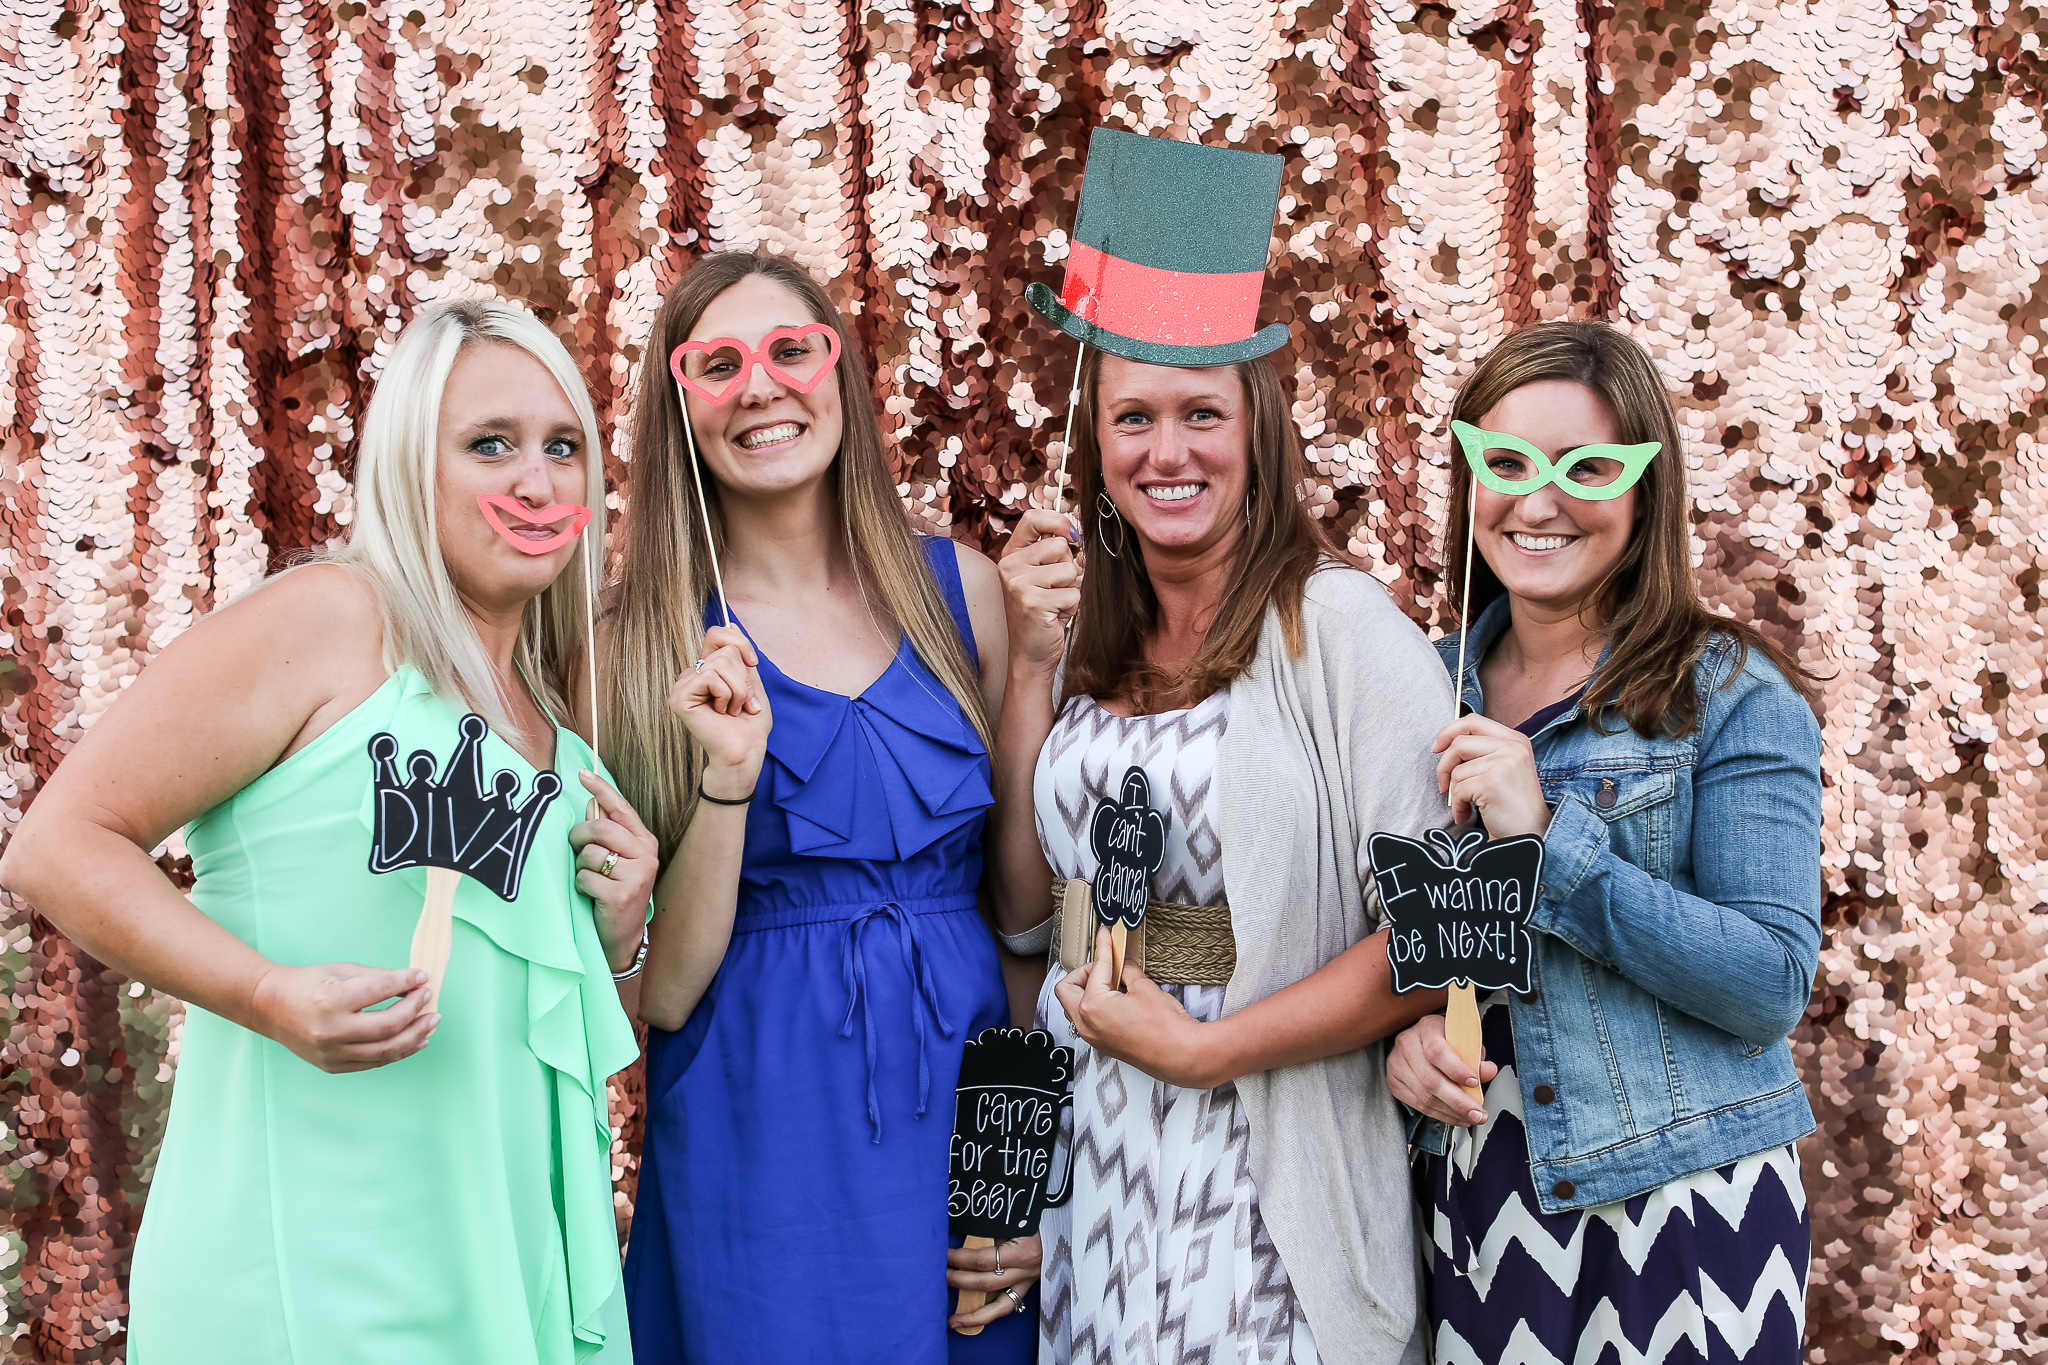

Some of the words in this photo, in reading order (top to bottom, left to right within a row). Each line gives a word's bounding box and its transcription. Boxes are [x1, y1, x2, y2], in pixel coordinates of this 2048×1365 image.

[1124, 782, 1144, 811] I
[379, 788, 522, 895] DIVA
[1108, 811, 1147, 858] can't
[1099, 855, 1148, 917] dance!
[1375, 862, 1417, 904] I
[1423, 877, 1522, 915] wanna
[1391, 927, 1426, 964] be
[1437, 920, 1517, 965] Next!
[976, 1092, 1053, 1136] came
[948, 1134, 993, 1174] for
[997, 1136, 1048, 1179] the
